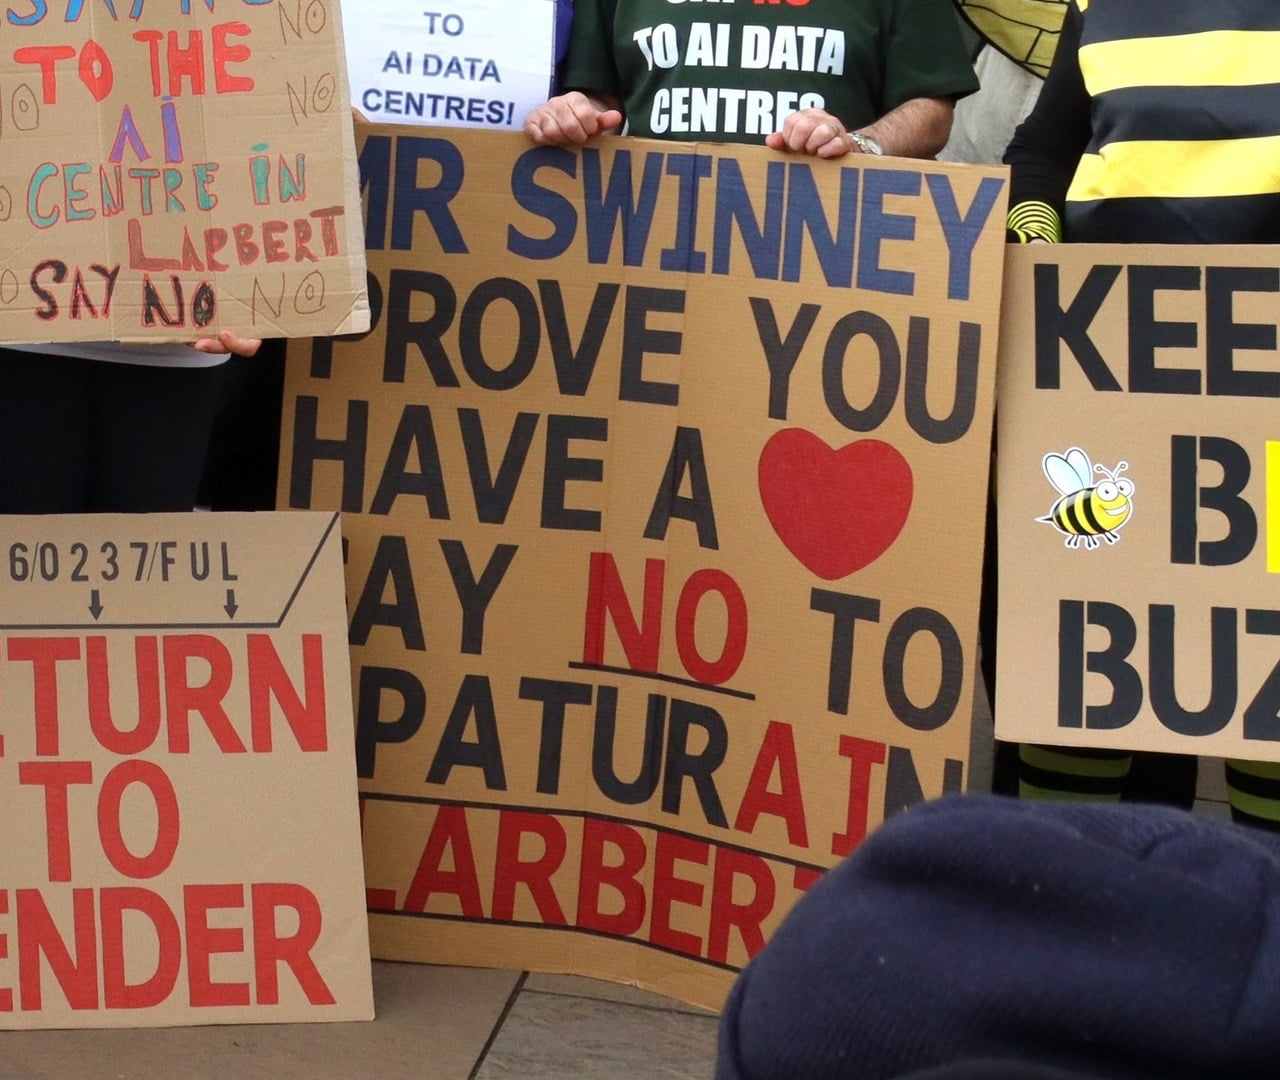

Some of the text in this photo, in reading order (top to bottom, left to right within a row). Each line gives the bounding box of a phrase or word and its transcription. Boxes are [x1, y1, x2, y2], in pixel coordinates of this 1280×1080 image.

[423, 11, 464, 37] TO
[632, 22, 846, 76] TO AI DATA
[13, 21, 255, 105] TO THE
[382, 50, 502, 84] AI DATA
[286, 72, 336, 126] NO
[362, 88, 516, 126] CENTRES!
[26, 162, 219, 230] CENTRE
[507, 147, 1005, 301] SWINNEY
[127, 204, 345, 273] LARBERT
[30, 258, 121, 320] SAY
[141, 274, 217, 328] NO
[252, 269, 328, 327] NO
[309, 270, 981, 444] PROVE YOU
[289, 395, 720, 550] HAVE A
[582, 551, 963, 730] NO TO
[18, 759, 180, 883] TO
